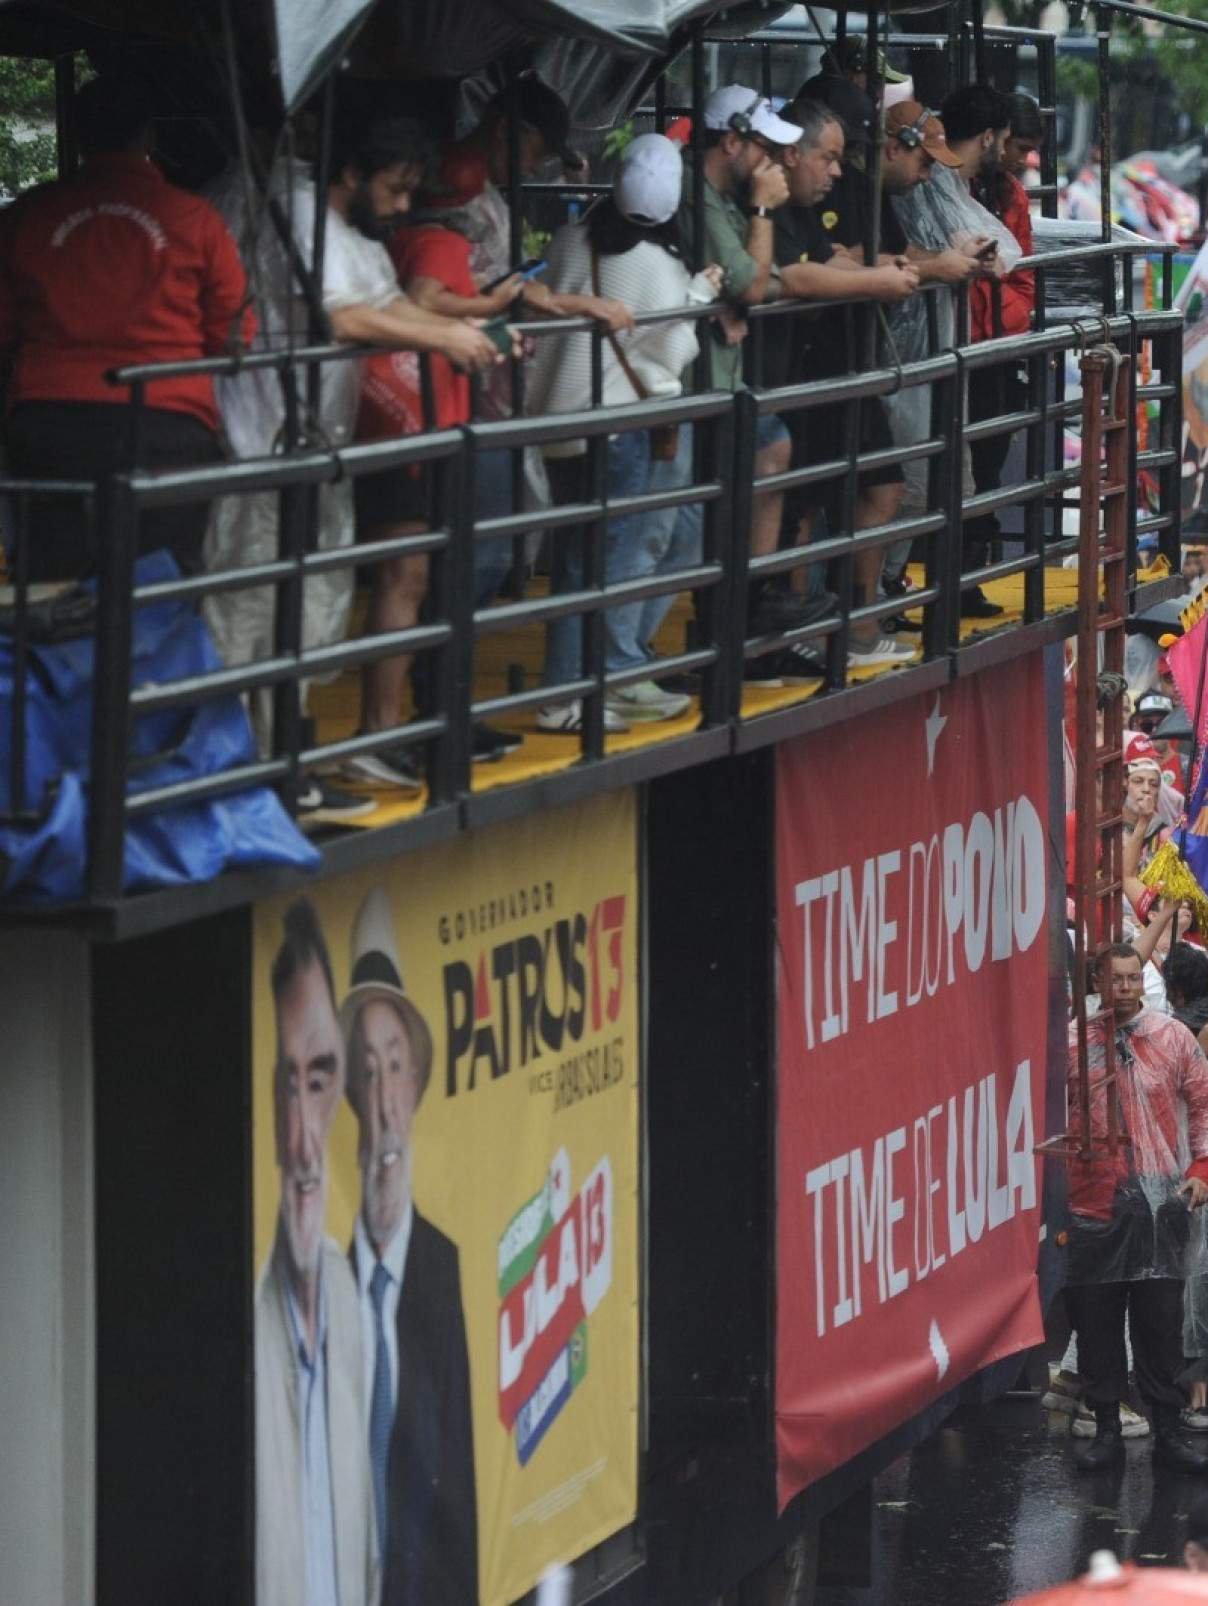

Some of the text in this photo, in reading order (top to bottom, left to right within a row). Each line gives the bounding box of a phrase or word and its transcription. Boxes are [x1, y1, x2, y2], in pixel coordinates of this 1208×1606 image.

[439, 882, 555, 946] GOVERNADOR
[443, 912, 588, 1098] PATRUS
[795, 849, 900, 1050] TIME
[906, 833, 943, 1006] DO
[500, 1217, 580, 1392] LULA
[586, 1171, 604, 1278] 13
[806, 1059, 1037, 1338] TIME DE LULA
